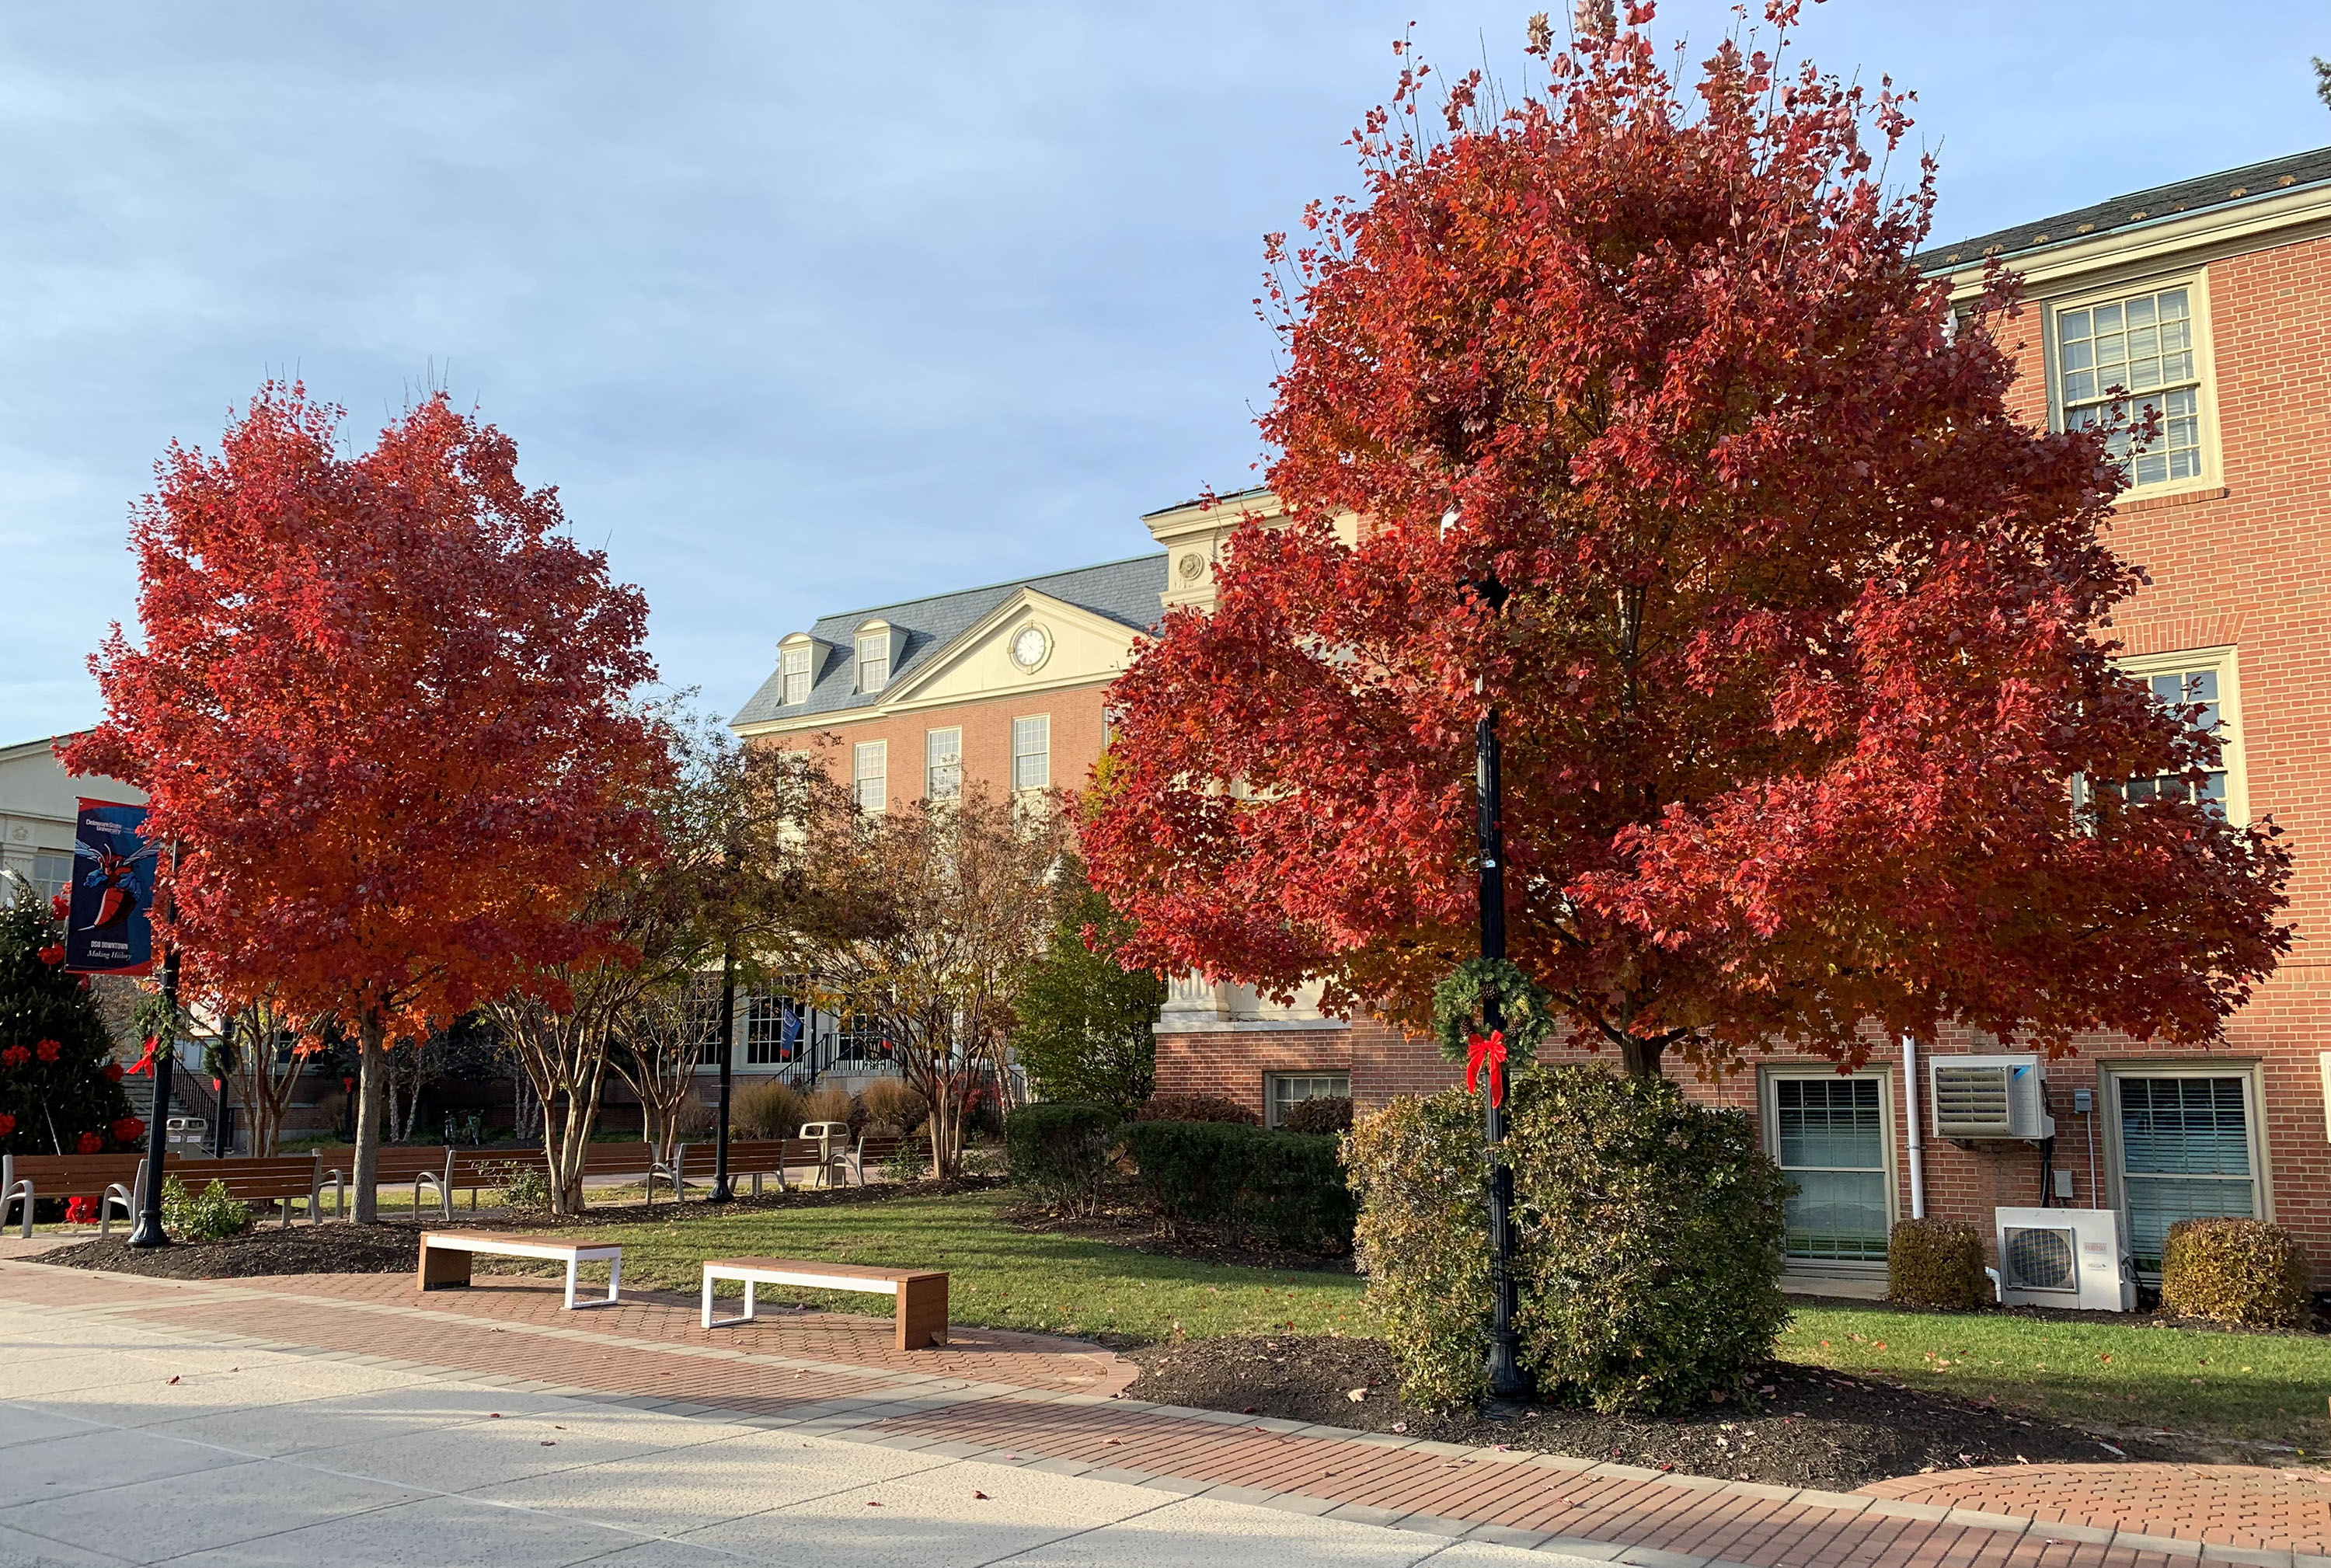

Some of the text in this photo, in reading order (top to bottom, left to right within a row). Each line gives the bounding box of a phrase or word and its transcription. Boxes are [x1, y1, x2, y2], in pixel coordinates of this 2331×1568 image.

[96, 825, 121, 835] University
[87, 950, 132, 961] Making History
